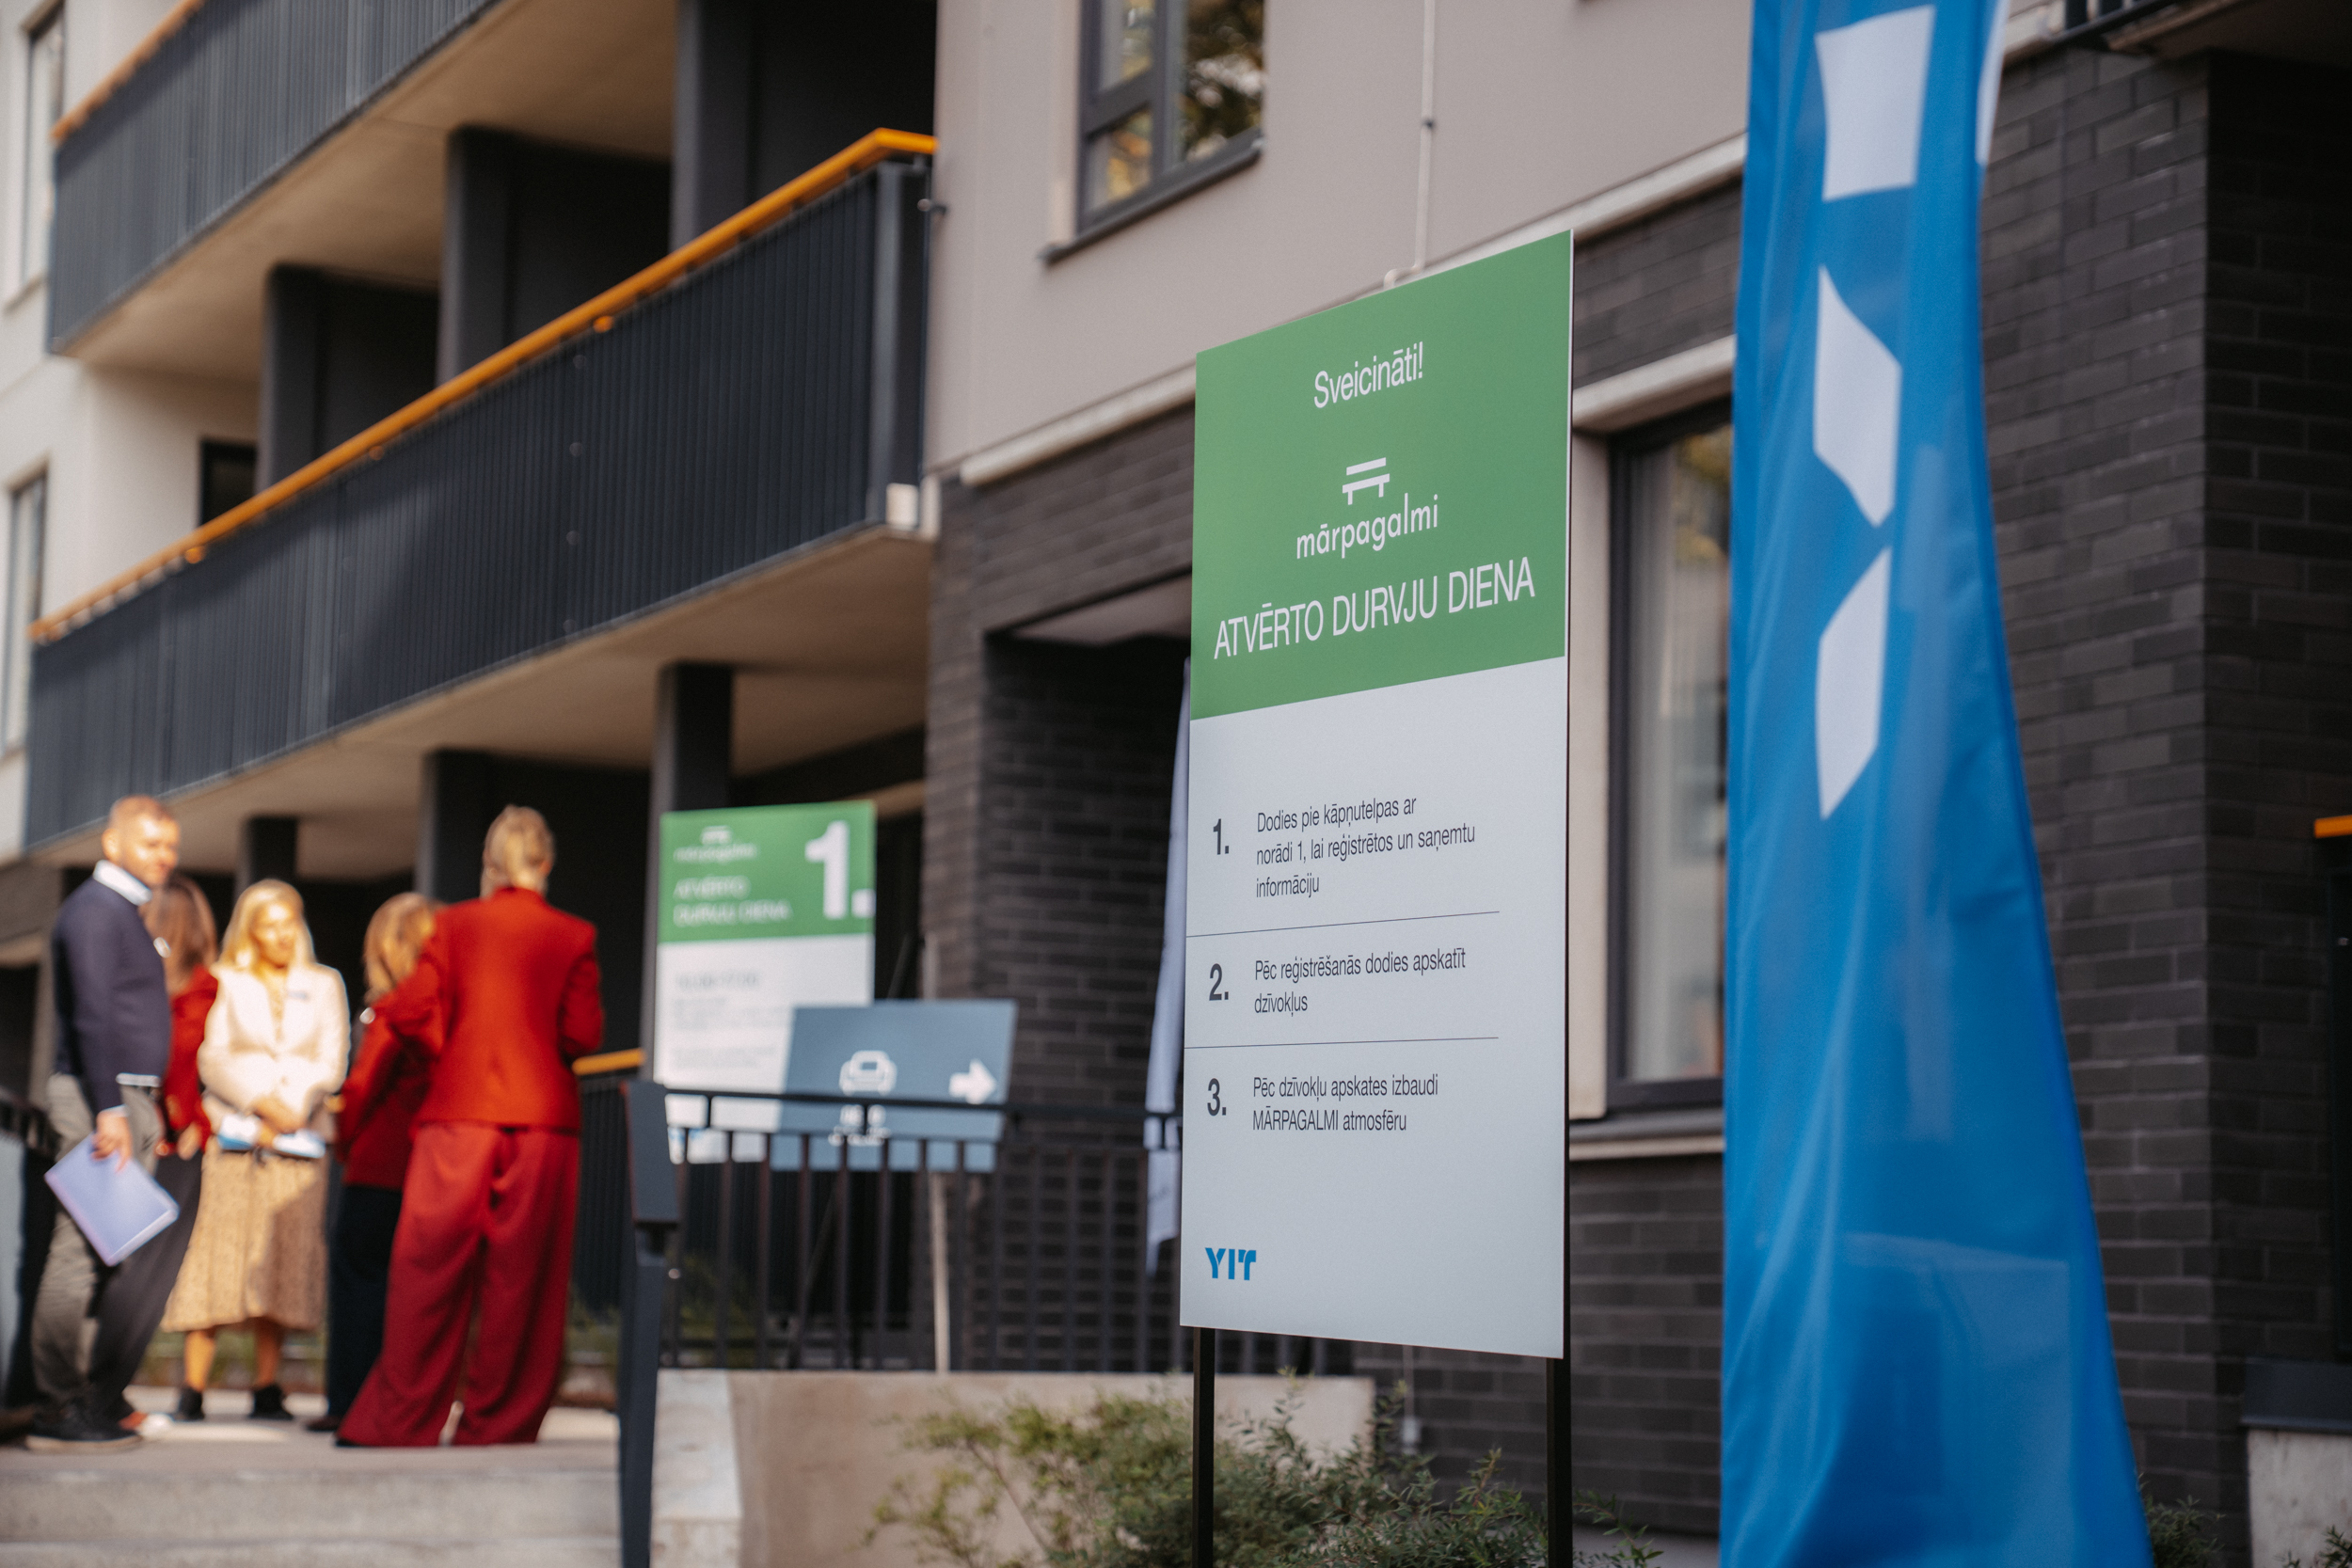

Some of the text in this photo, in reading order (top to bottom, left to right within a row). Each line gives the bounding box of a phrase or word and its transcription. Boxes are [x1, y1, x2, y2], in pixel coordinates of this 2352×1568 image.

[1314, 341, 1422, 408] Sveicināti!
[1297, 493, 1438, 559] mārpagalmi
[1215, 557, 1534, 659] ATVĒRTO DURVJU DIENA
[1258, 799, 1416, 832] Dodies pie kāpņutelpas ar
[1214, 818, 1229, 855] 1.
[1257, 823, 1474, 864] norādi 1, lai reģistrētos un saņemtu
[803, 820, 875, 919] 1.
[1257, 875, 1319, 897] informāciju
[1209, 963, 1229, 1001] 2.
[1256, 948, 1466, 984] Pēc reģistrēšanās dodies apskatīt
[1255, 992, 1308, 1016] dzīvokļus
[1207, 1078, 1226, 1116] 3.
[1254, 1074, 1438, 1101] Pēc dzīvokļu apskates izbaudi
[1253, 1106, 1406, 1131] MĀRPAGALMI atmosfēru
[1205, 1248, 1256, 1280] YIT
